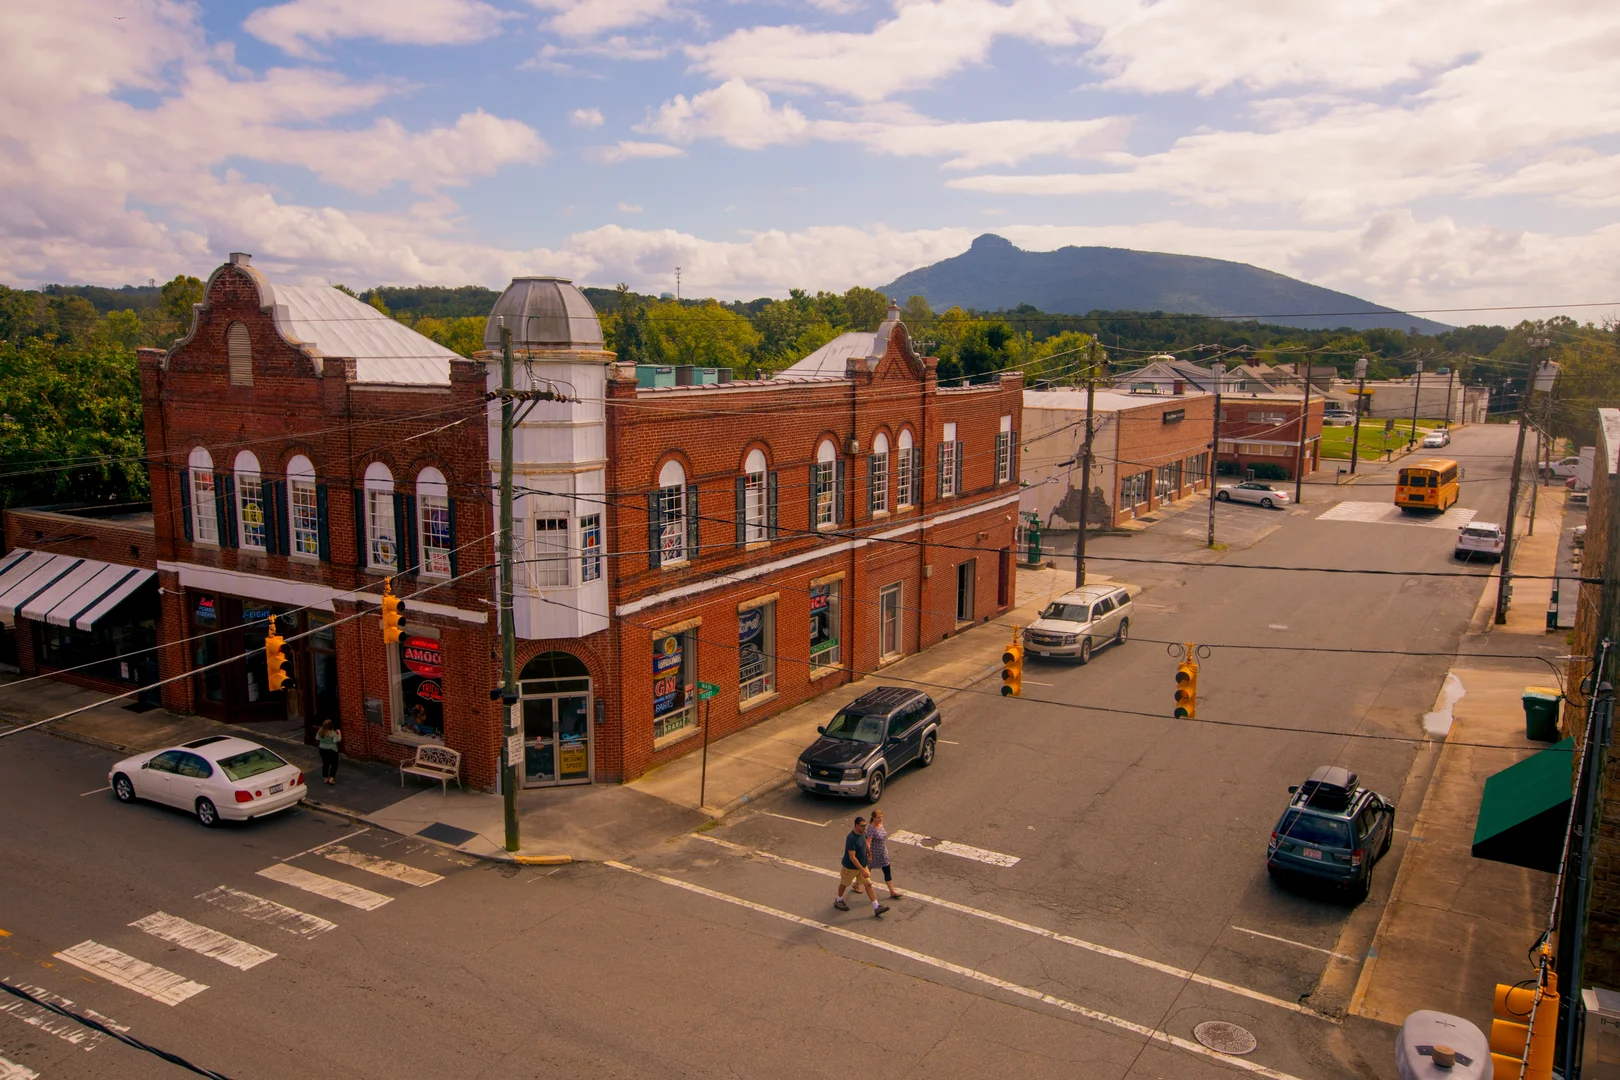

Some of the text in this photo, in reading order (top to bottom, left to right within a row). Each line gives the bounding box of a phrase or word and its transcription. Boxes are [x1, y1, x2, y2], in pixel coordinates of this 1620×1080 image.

[810, 595, 827, 609] ICK
[739, 613, 760, 633] ord
[404, 648, 441, 664] AMOC
[655, 676, 676, 697] GM
[655, 699, 674, 713] PARTS
